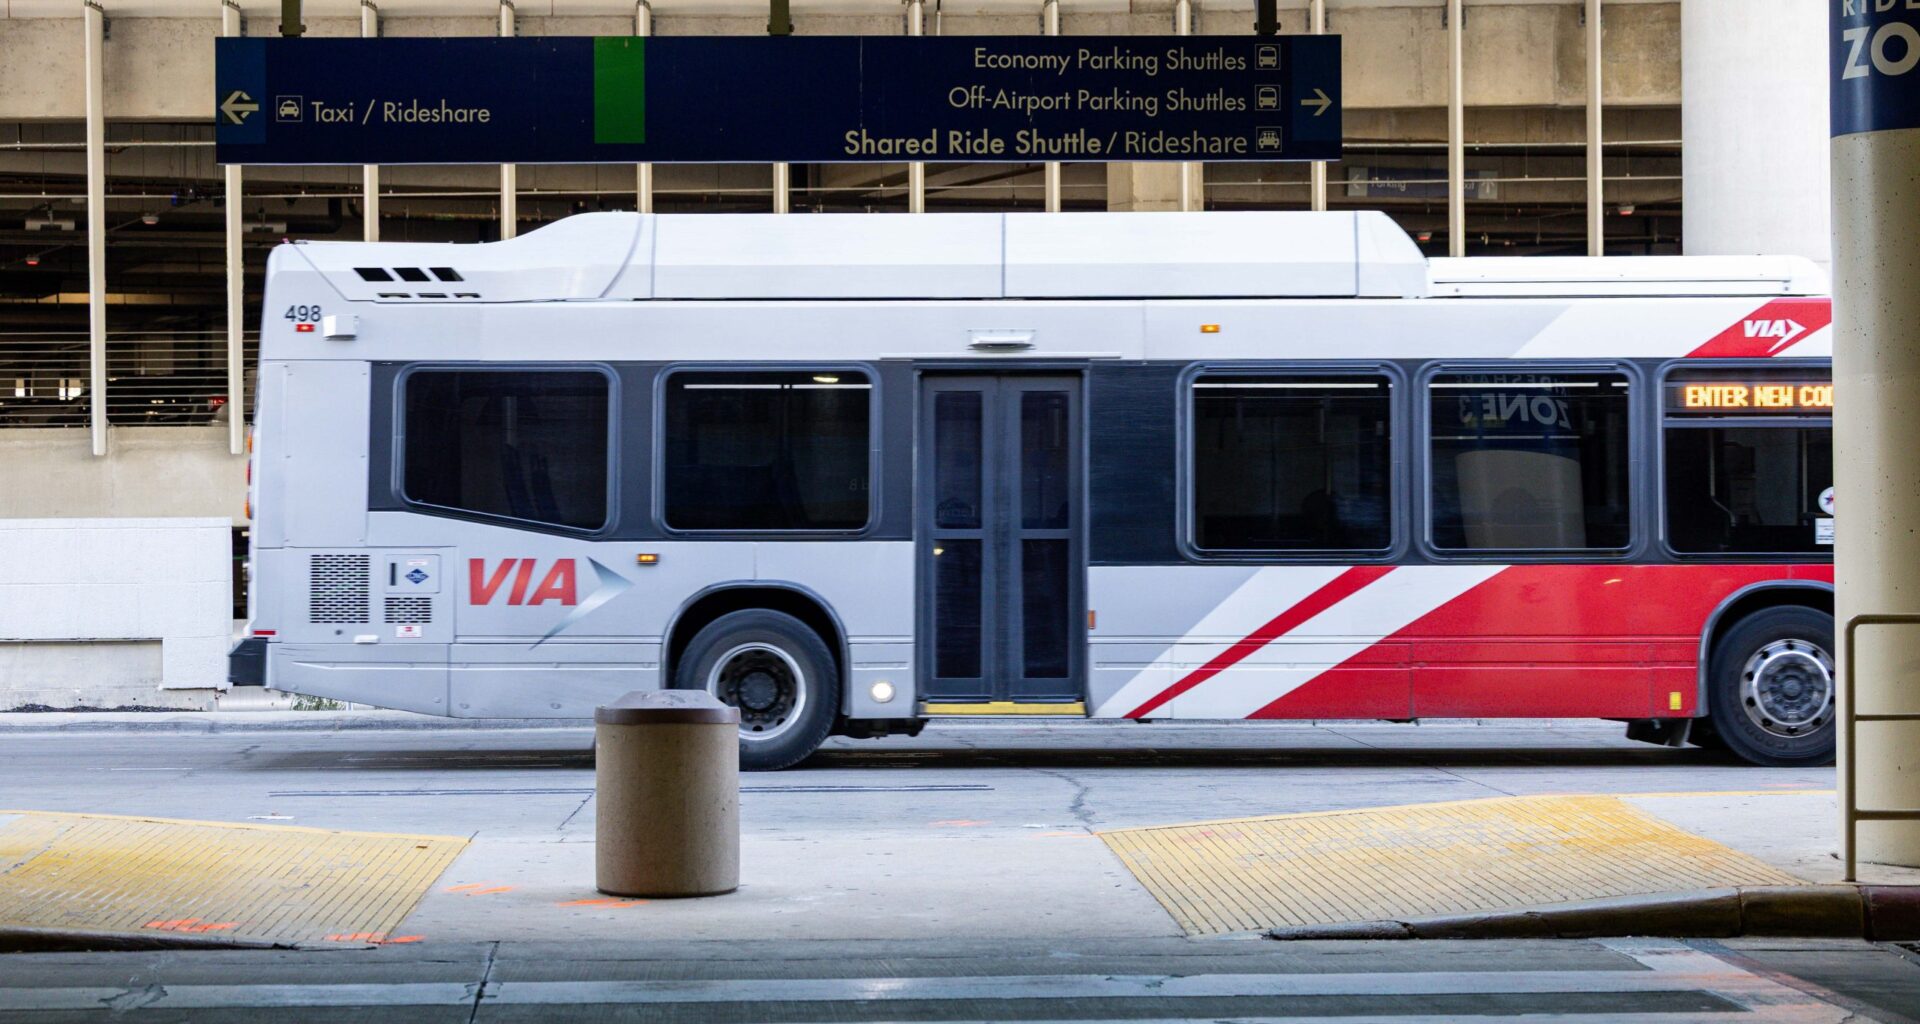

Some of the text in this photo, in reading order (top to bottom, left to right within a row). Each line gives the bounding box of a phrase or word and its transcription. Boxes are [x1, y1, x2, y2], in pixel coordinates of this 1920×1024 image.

[974, 47, 1246, 76] Economy Parking Shuttles
[311, 101, 354, 123] Taxi
[383, 98, 490, 123] Rideshare
[948, 86, 1246, 117] Off-Airport Parking Shuttles
[844, 129, 937, 155] Shared
[949, 129, 1005, 155] Ride
[1015, 129, 1102, 155] Shuttle
[1125, 130, 1248, 154] Rideshare
[284, 305, 322, 322] 498
[1743, 319, 1787, 338] VIA
[1685, 385, 1749, 407] ENTER
[1753, 385, 1794, 407] NEW
[469, 558, 577, 606] VIA
